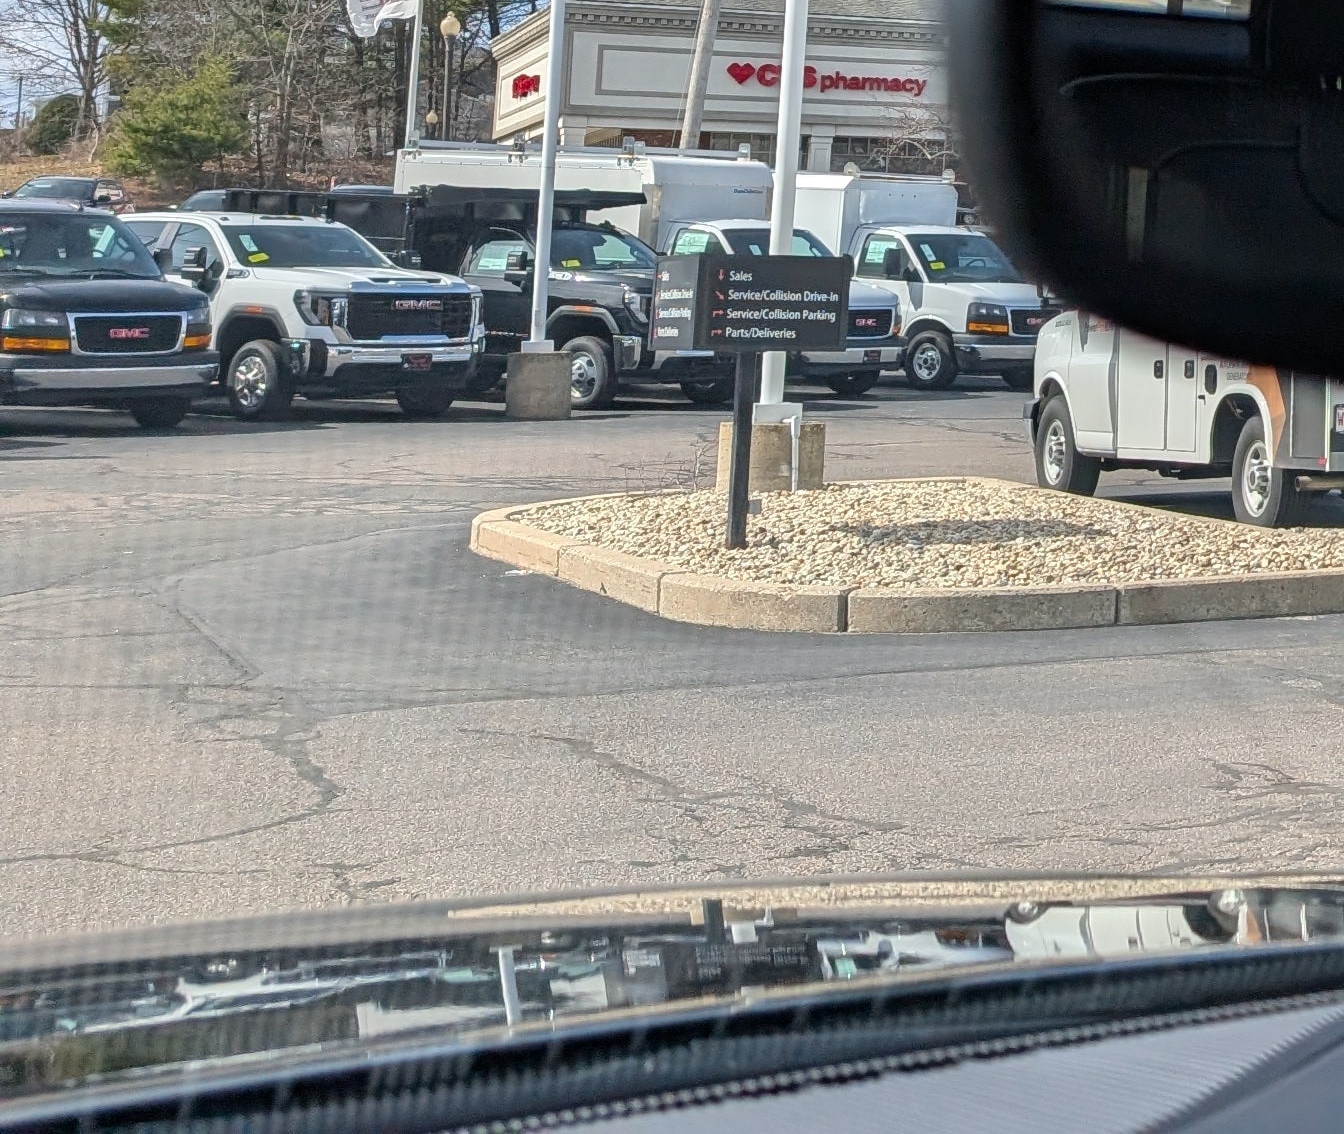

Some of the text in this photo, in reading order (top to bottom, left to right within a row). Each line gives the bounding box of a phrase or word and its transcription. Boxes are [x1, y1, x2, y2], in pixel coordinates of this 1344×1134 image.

[757, 64, 928, 97] CS pharmacy
[729, 271, 753, 282] Sales
[728, 289, 839, 302] Service/Collision Drive-In
[396, 299, 442, 311] GMC
[726, 308, 837, 323] Service/Collision Parking
[109, 328, 150, 339] GMC
[725, 326, 797, 339] Parts/Deliveries
